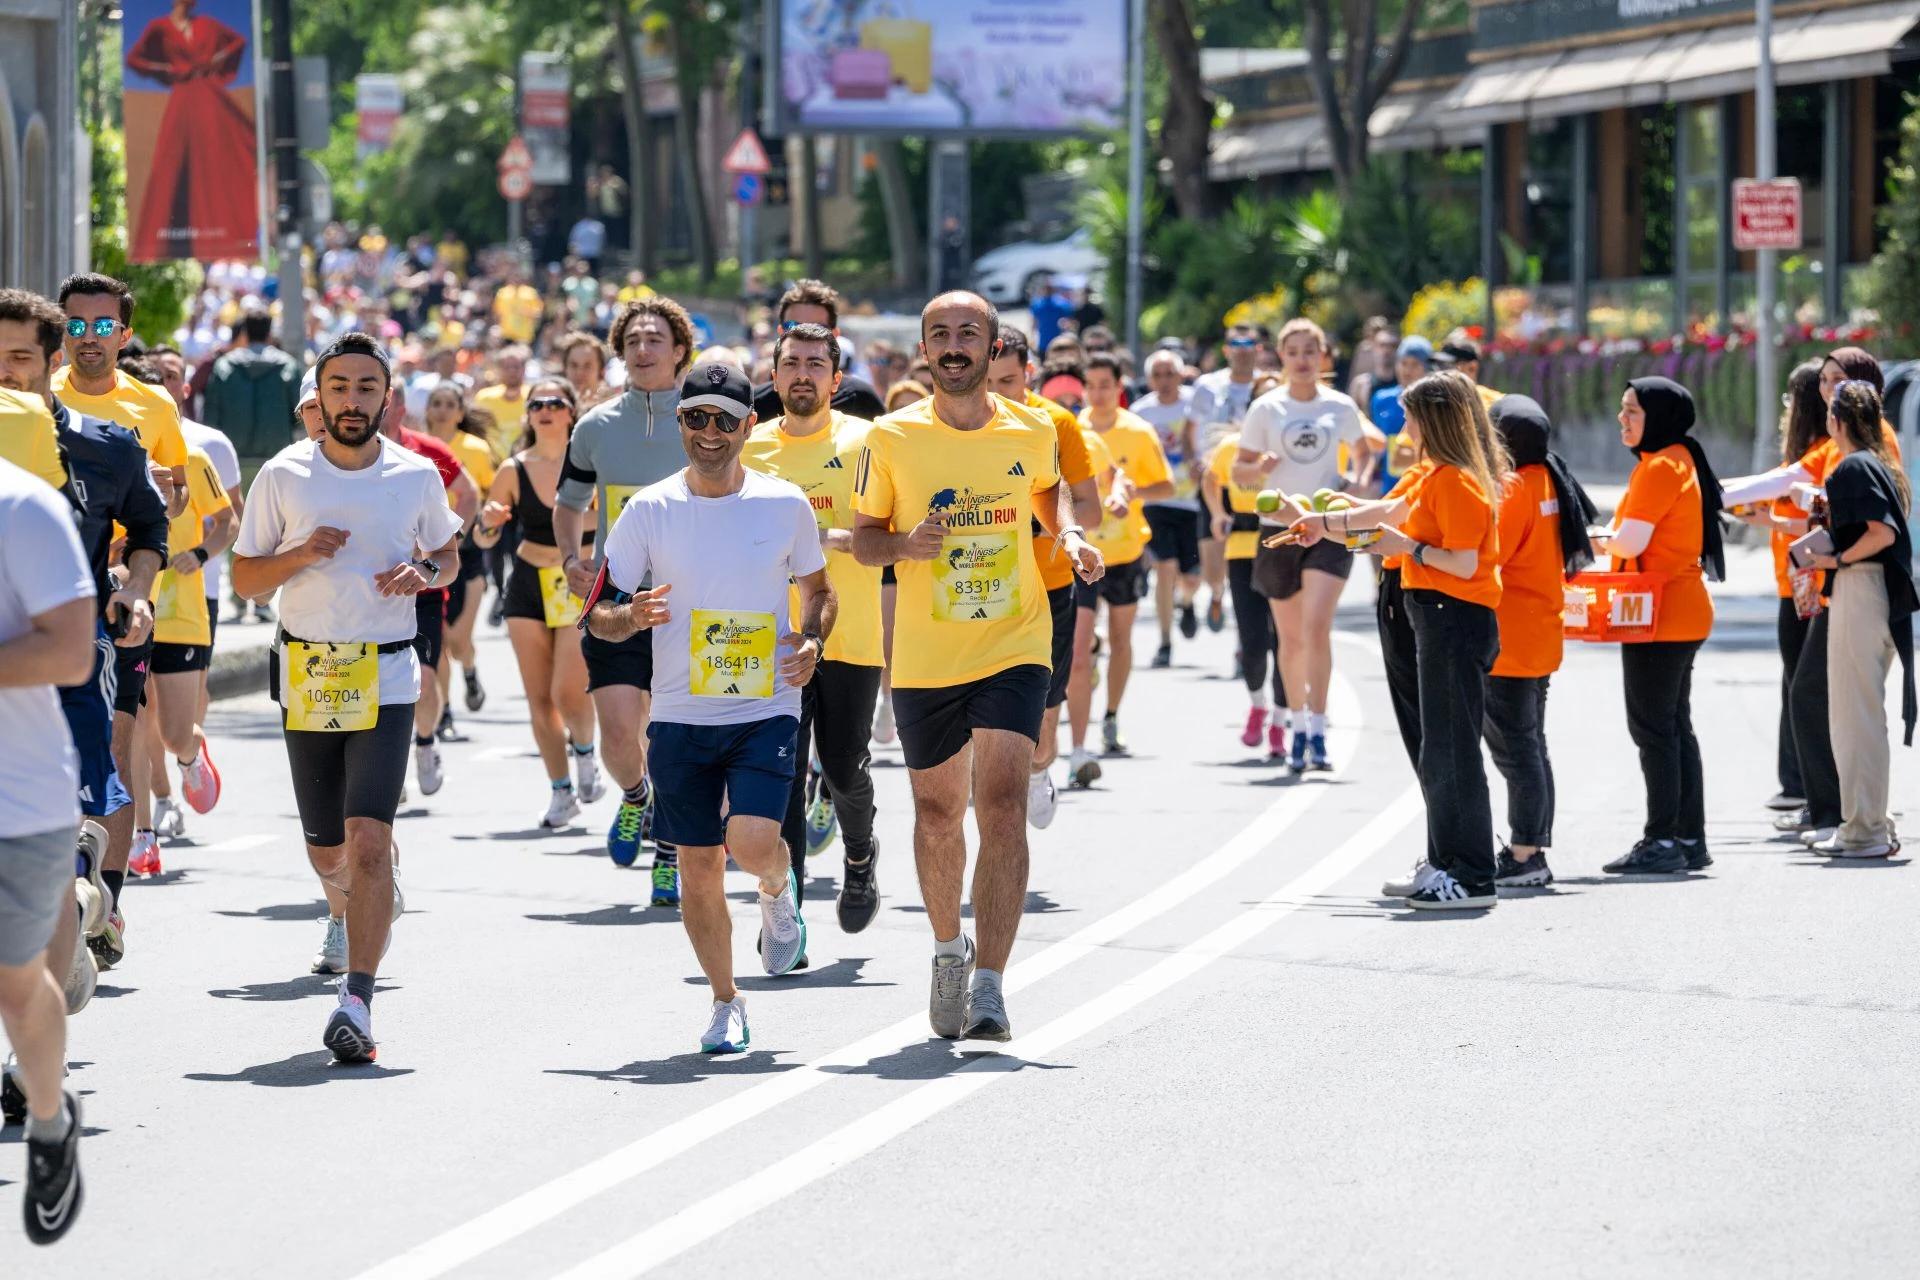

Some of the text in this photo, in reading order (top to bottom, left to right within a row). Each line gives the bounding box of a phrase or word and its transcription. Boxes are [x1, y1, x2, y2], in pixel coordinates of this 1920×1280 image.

[809, 496, 833, 510] RUN
[956, 496, 991, 505] WINGS
[961, 503, 981, 512] LIFE
[946, 507, 1017, 528] WORLD RUN
[955, 578, 1000, 594] 83319
[1620, 596, 1644, 623] M
[721, 625, 750, 633] WINGS
[706, 655, 760, 670] 186413
[307, 688, 361, 703] 106704
